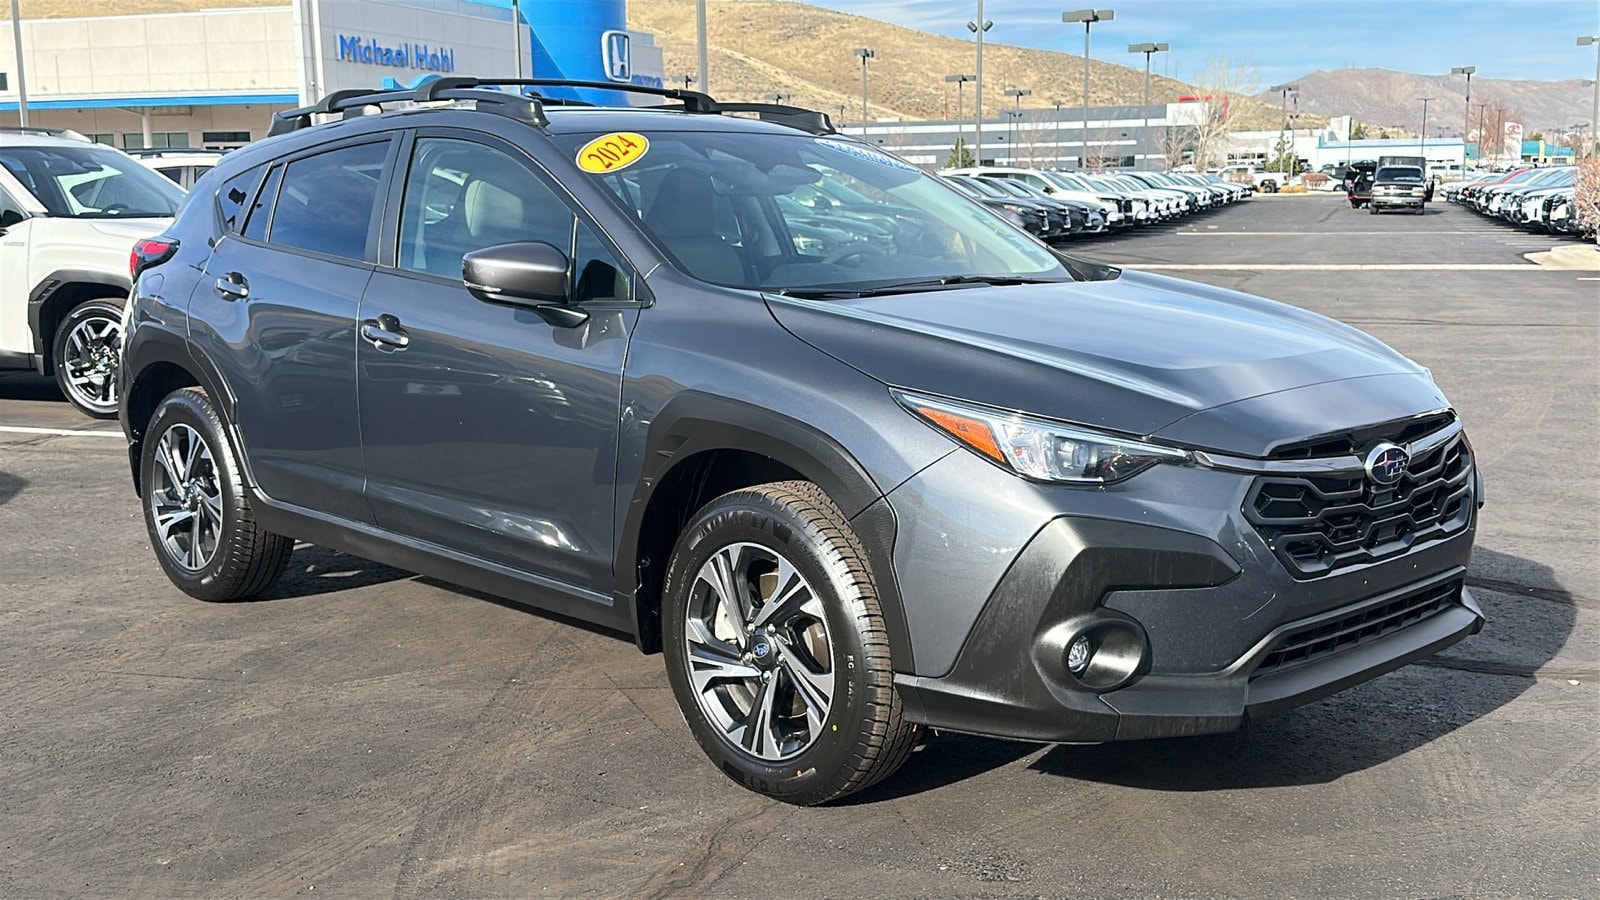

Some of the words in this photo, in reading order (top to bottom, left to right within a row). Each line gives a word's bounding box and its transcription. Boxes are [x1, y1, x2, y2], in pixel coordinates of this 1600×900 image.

[339, 34, 409, 67] Michael
[415, 43, 455, 72] Hohl
[588, 135, 638, 169] 2024
